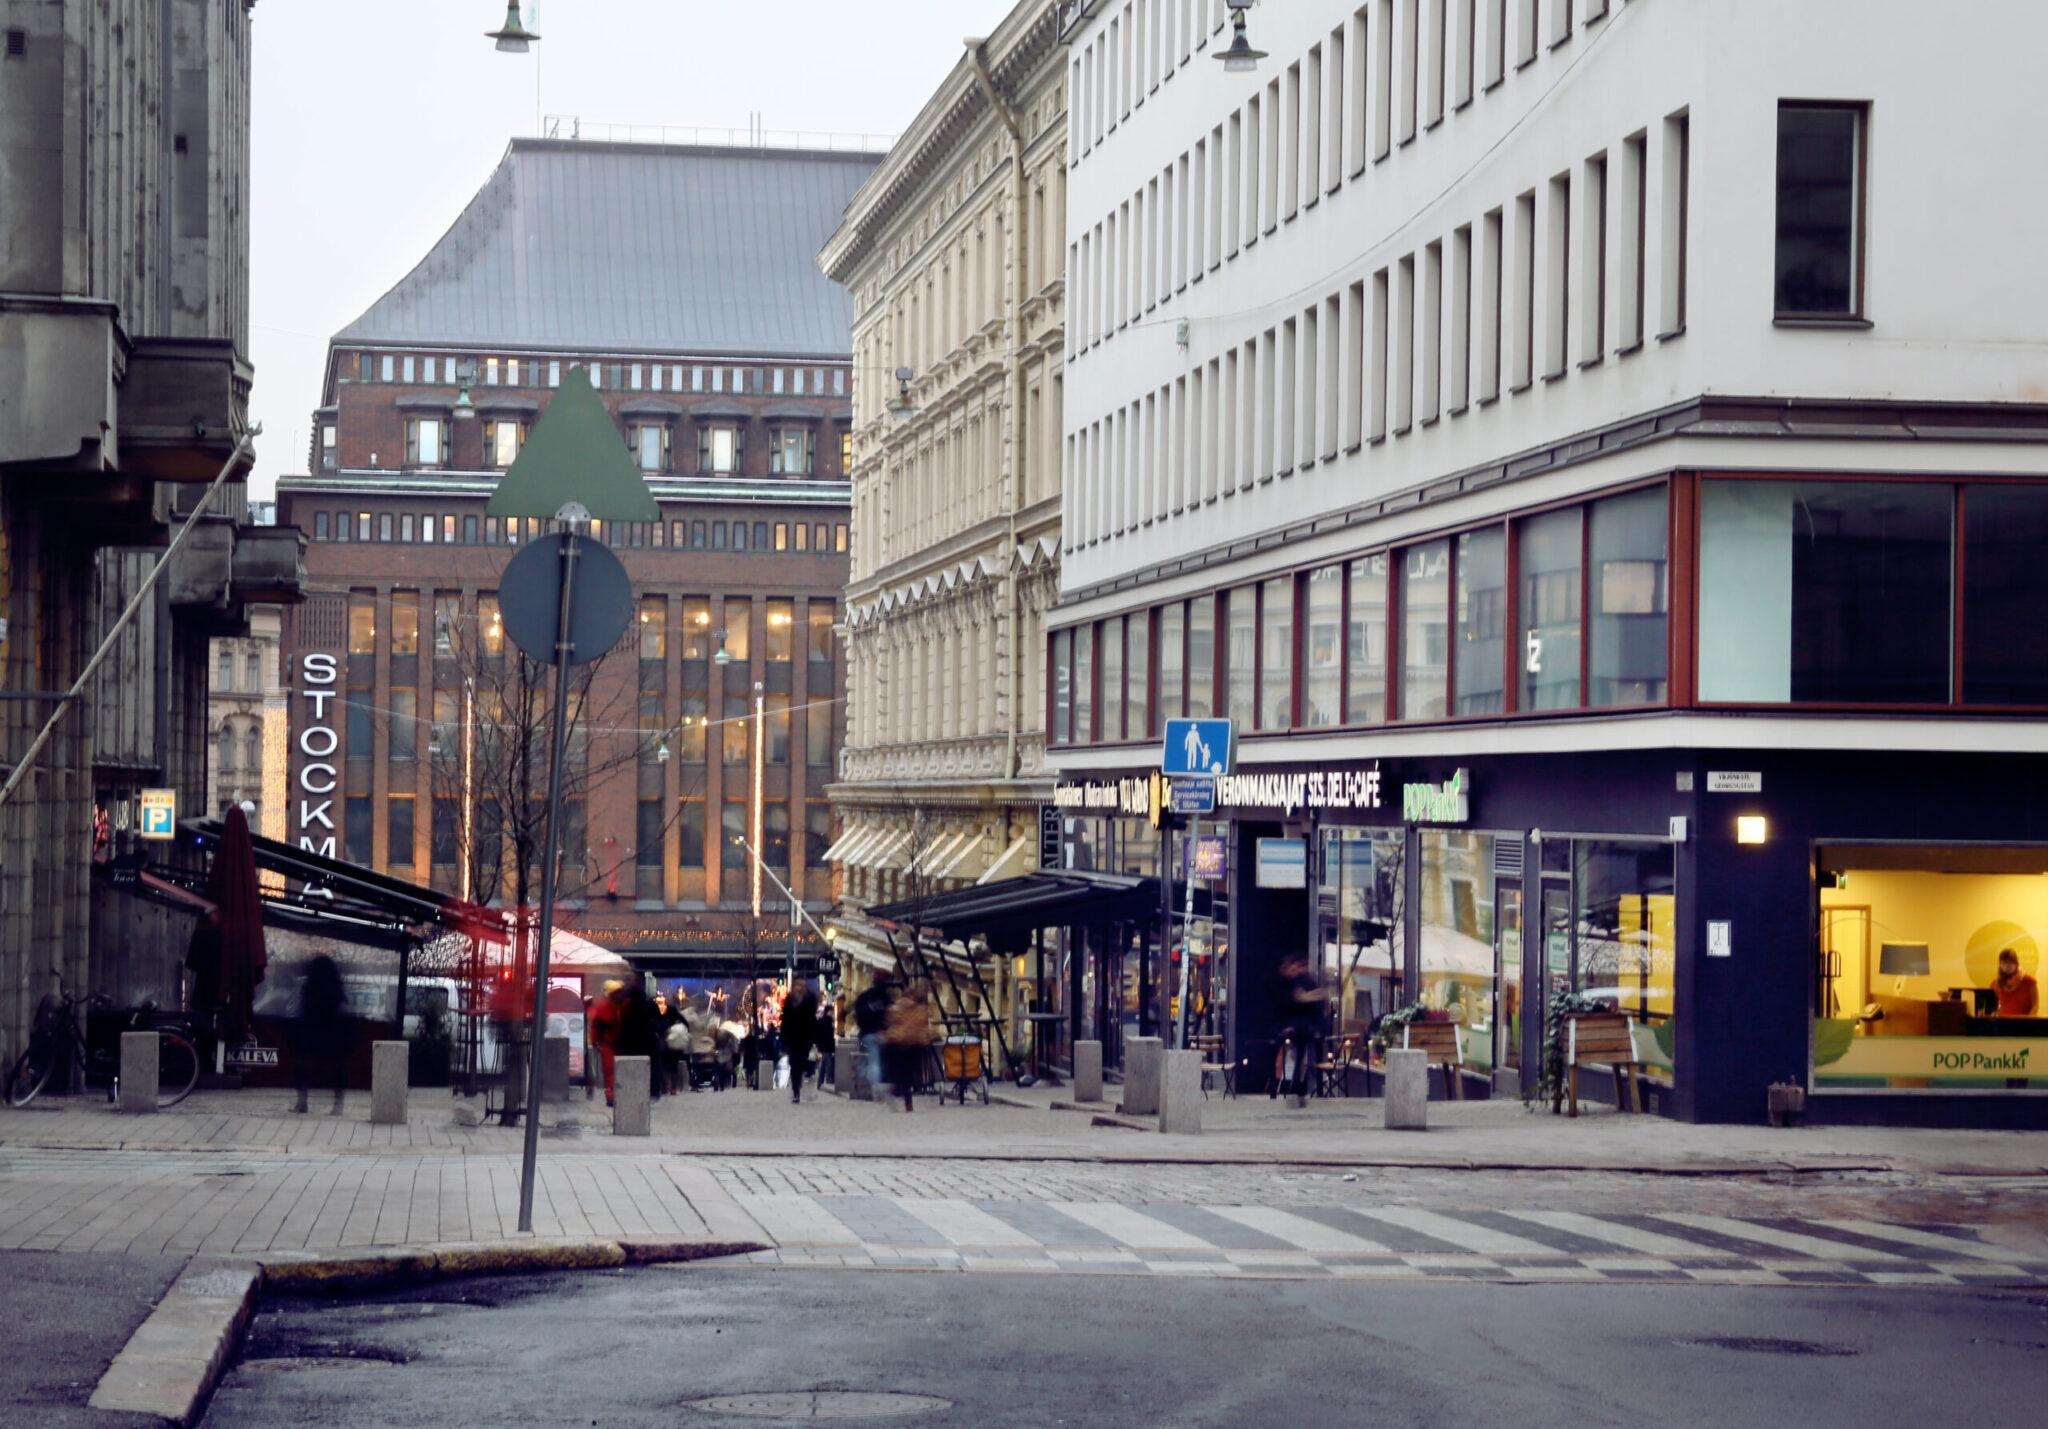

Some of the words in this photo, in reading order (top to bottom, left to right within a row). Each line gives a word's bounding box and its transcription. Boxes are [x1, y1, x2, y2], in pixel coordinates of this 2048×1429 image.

[1216, 773, 1306, 817] VERONMAKSAJAT
[819, 957, 837, 970] Bar
[226, 1050, 279, 1063] KALEVA
